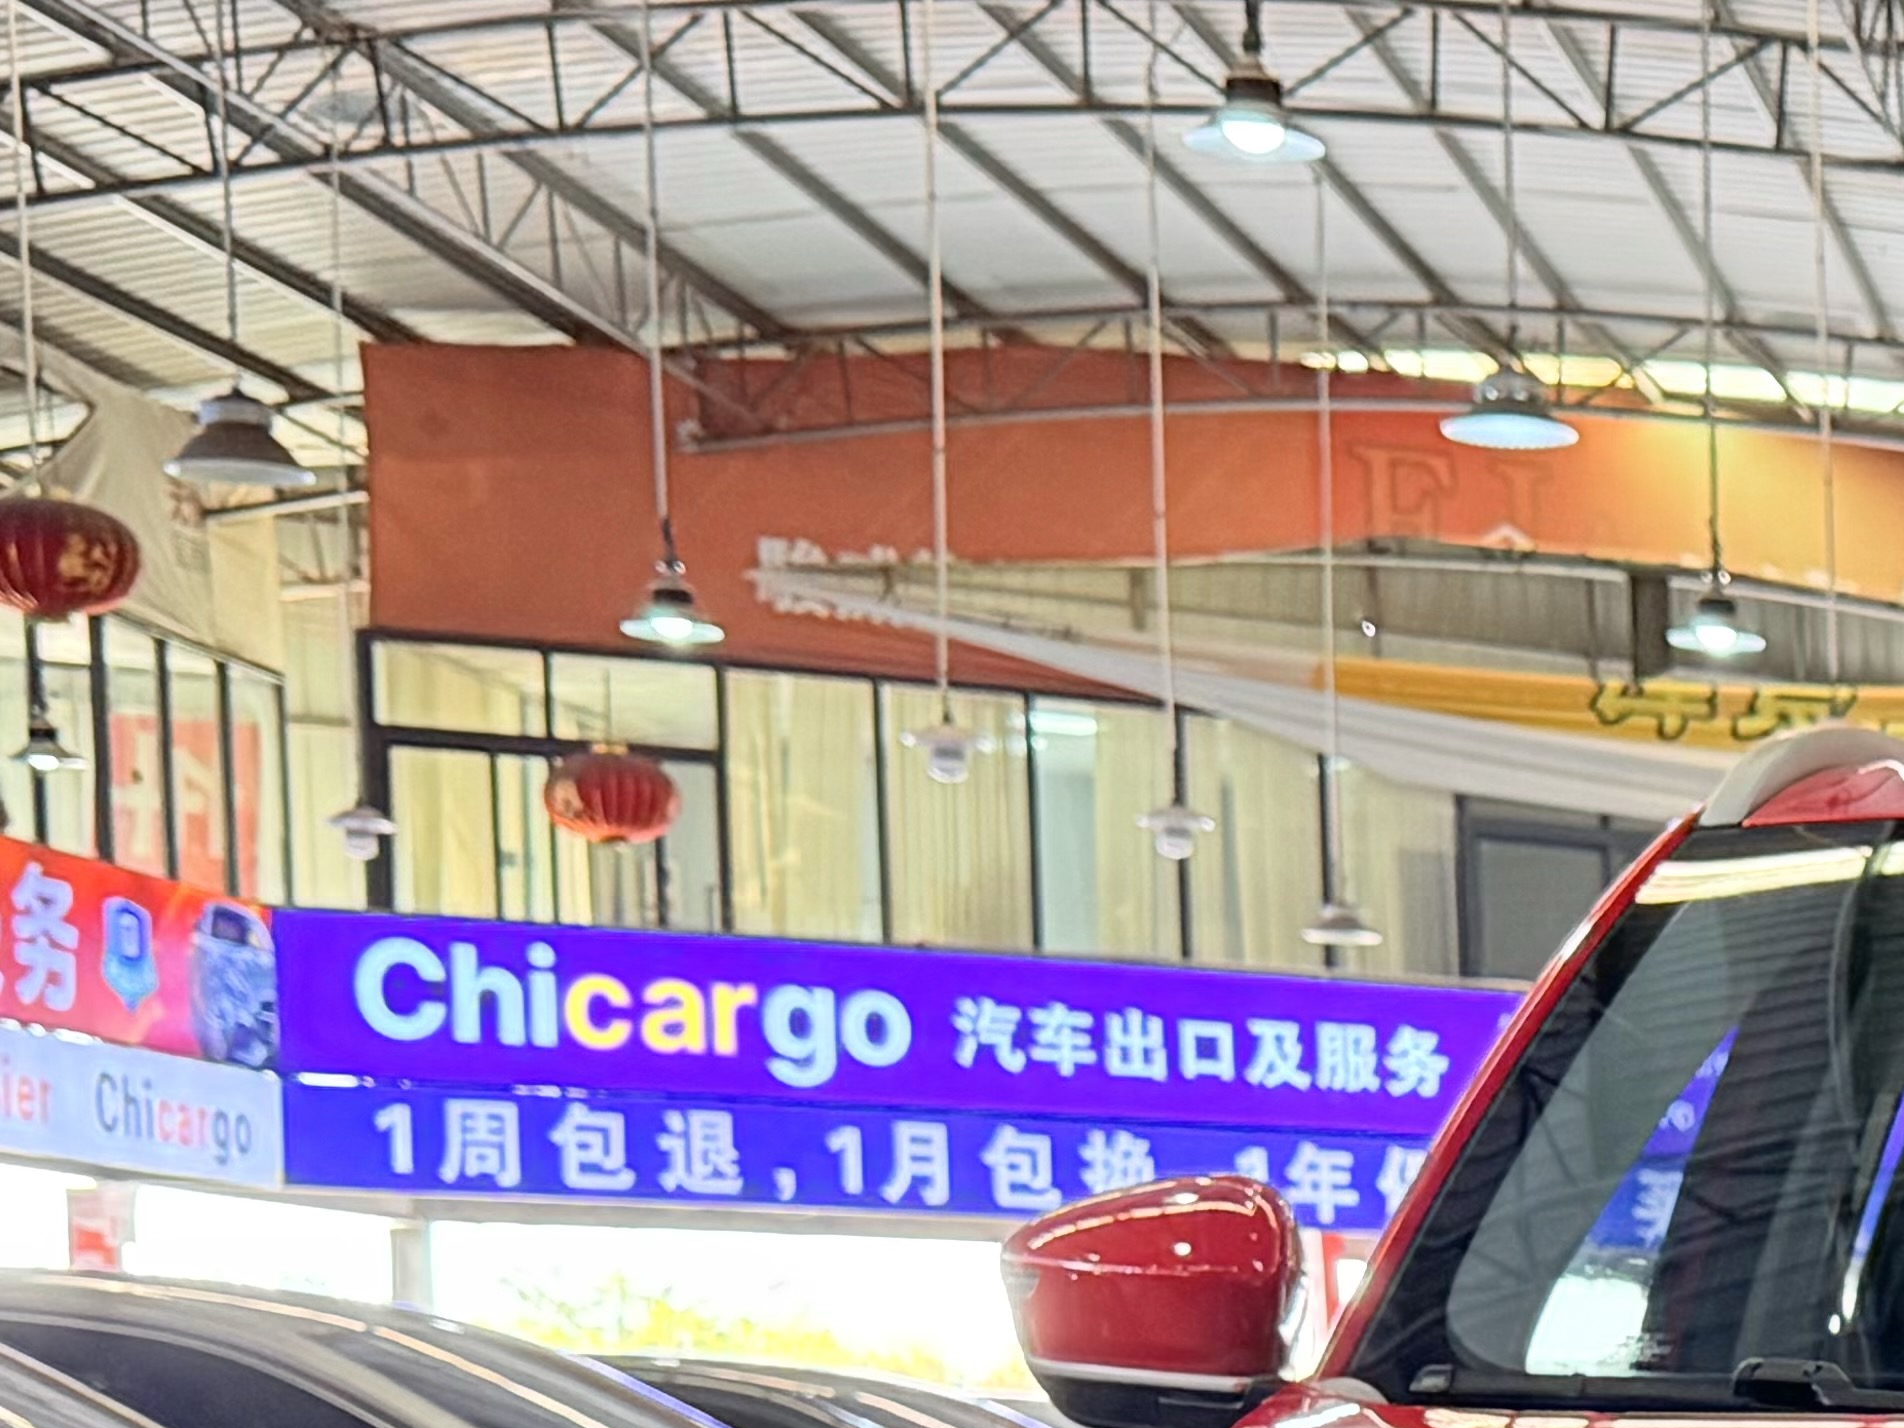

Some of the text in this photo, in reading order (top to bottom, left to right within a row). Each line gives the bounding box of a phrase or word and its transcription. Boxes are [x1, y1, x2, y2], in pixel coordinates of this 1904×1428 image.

[0, 861, 79, 1012] 务
[354, 936, 913, 1088] Chicargo
[951, 995, 1451, 1099] 汽车出口及服务
[94, 1070, 253, 1166] Chicargo
